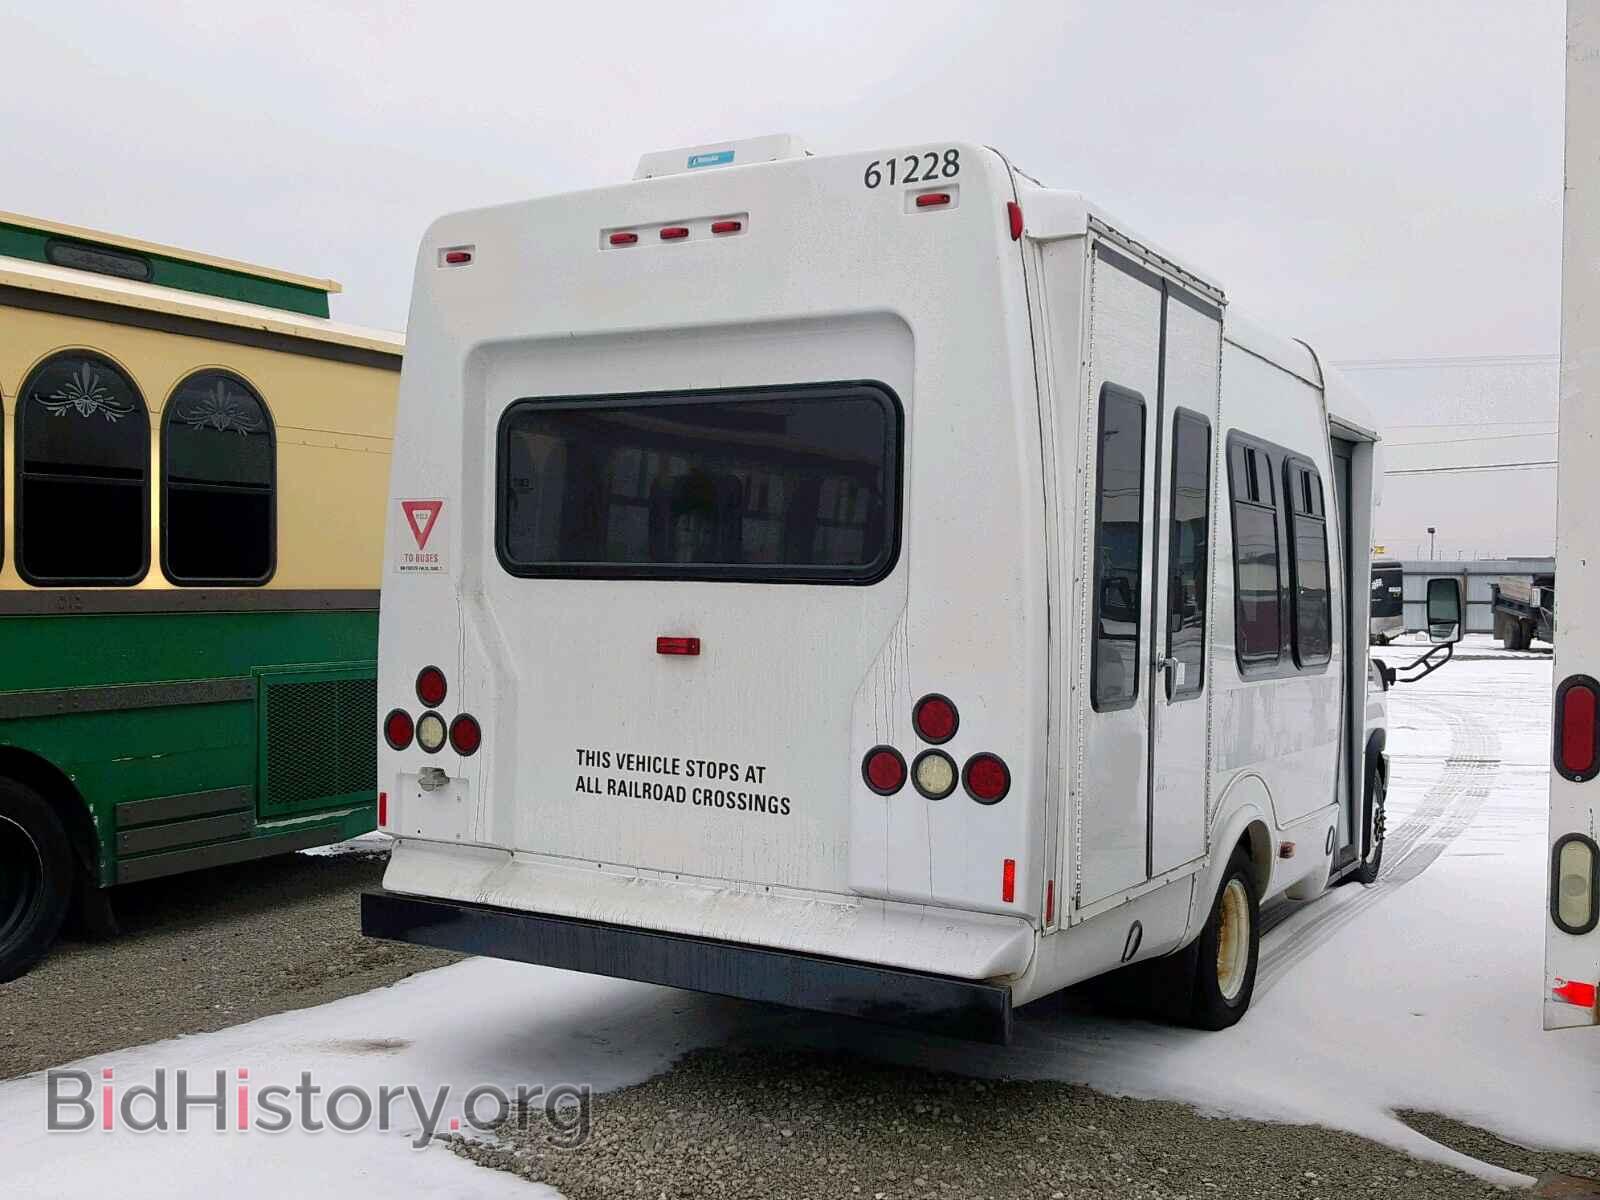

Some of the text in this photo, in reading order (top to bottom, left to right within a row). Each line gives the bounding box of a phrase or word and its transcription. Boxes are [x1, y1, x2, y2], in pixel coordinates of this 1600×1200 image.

[864, 149, 960, 189] 61228
[404, 553, 413, 562] TO
[576, 749, 766, 784] THIS VEHICLE STOPS AT
[575, 776, 791, 815] ALL RAILROAD CROSSINGS
